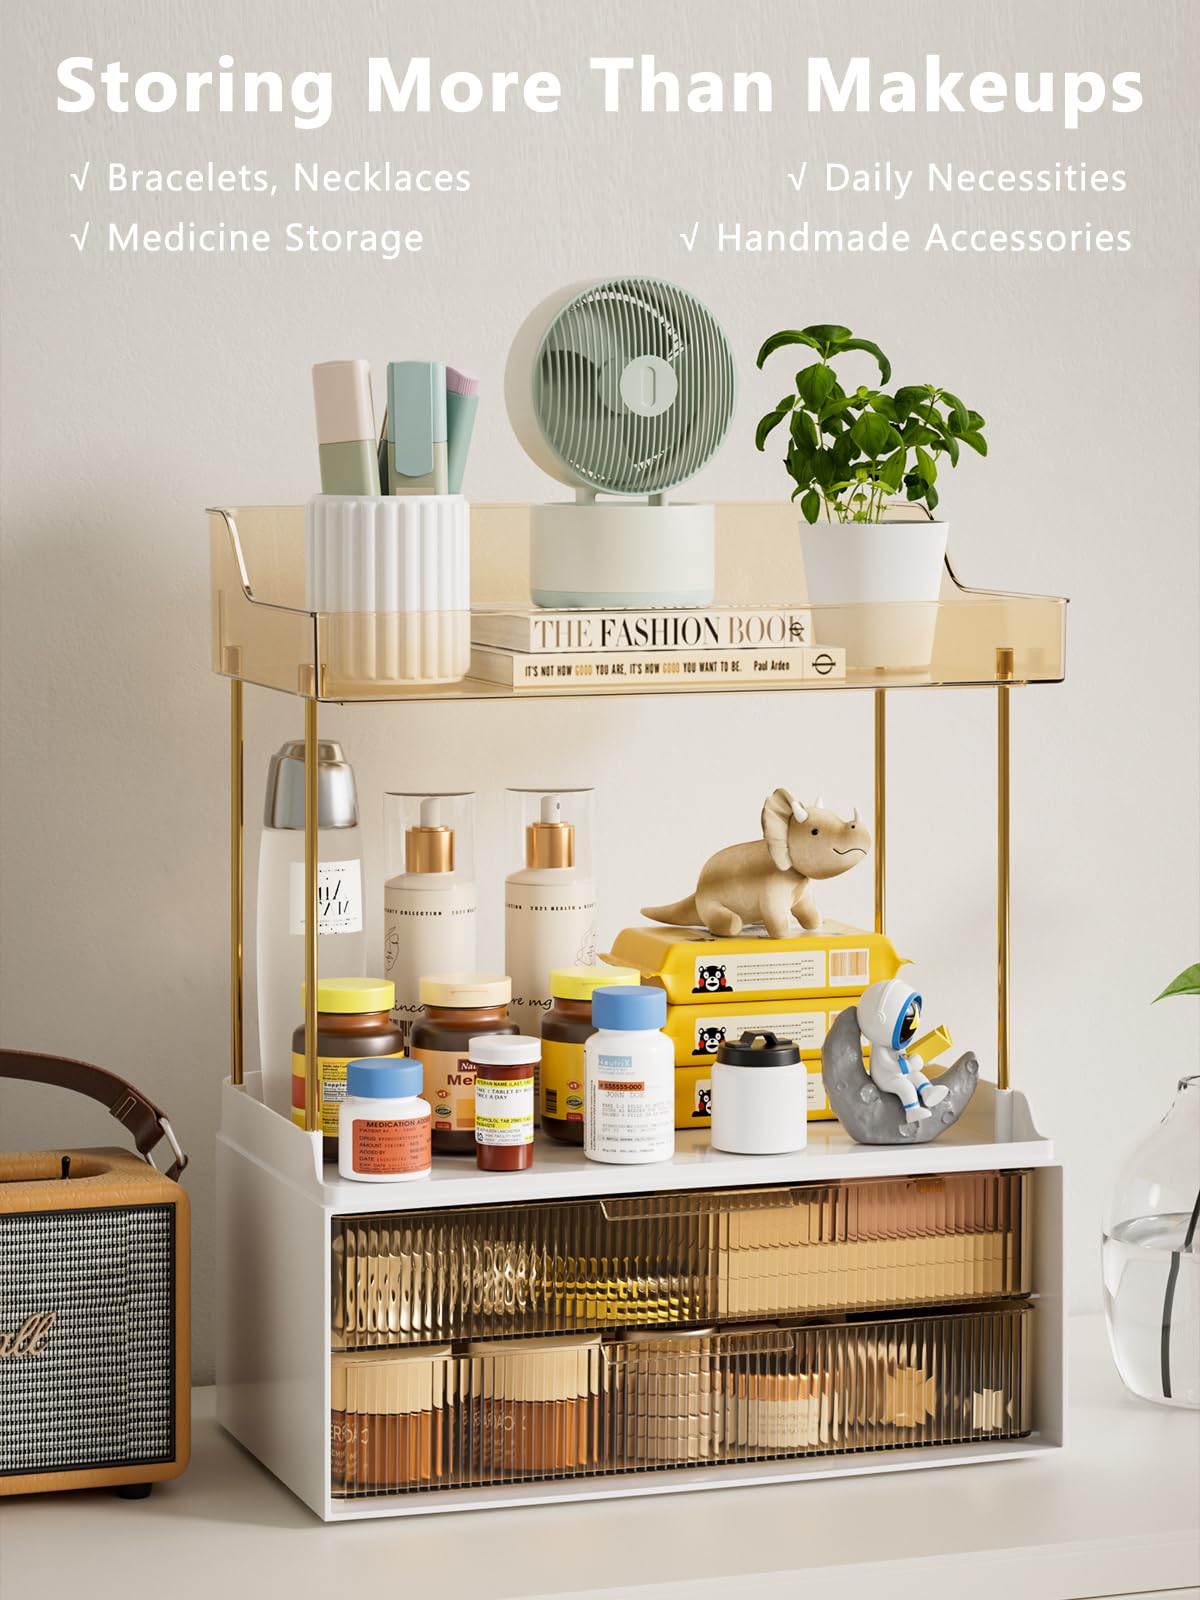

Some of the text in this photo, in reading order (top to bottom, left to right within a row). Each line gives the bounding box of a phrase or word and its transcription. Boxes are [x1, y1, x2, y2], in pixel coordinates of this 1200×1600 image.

[535, 619, 592, 648] THE
[600, 616, 720, 647] FASHION
[525, 666, 538, 677] IT'S
[541, 665, 554, 676] NOT
[557, 665, 572, 676] HOW
[575, 664, 593, 676] GOOD
[596, 664, 609, 675] YOU
[629, 663, 643, 674] IT'S
[645, 663, 660, 674] HOW
[662, 662, 680, 674] GOOD
[683, 662, 696, 673] YOU
[699, 661, 718, 673] WANT
[720, 661, 729, 672] TO
[753, 660, 768, 671] Paul
[771, 660, 790, 671] Arden
[366, 1119, 416, 1128] MEDICATION
